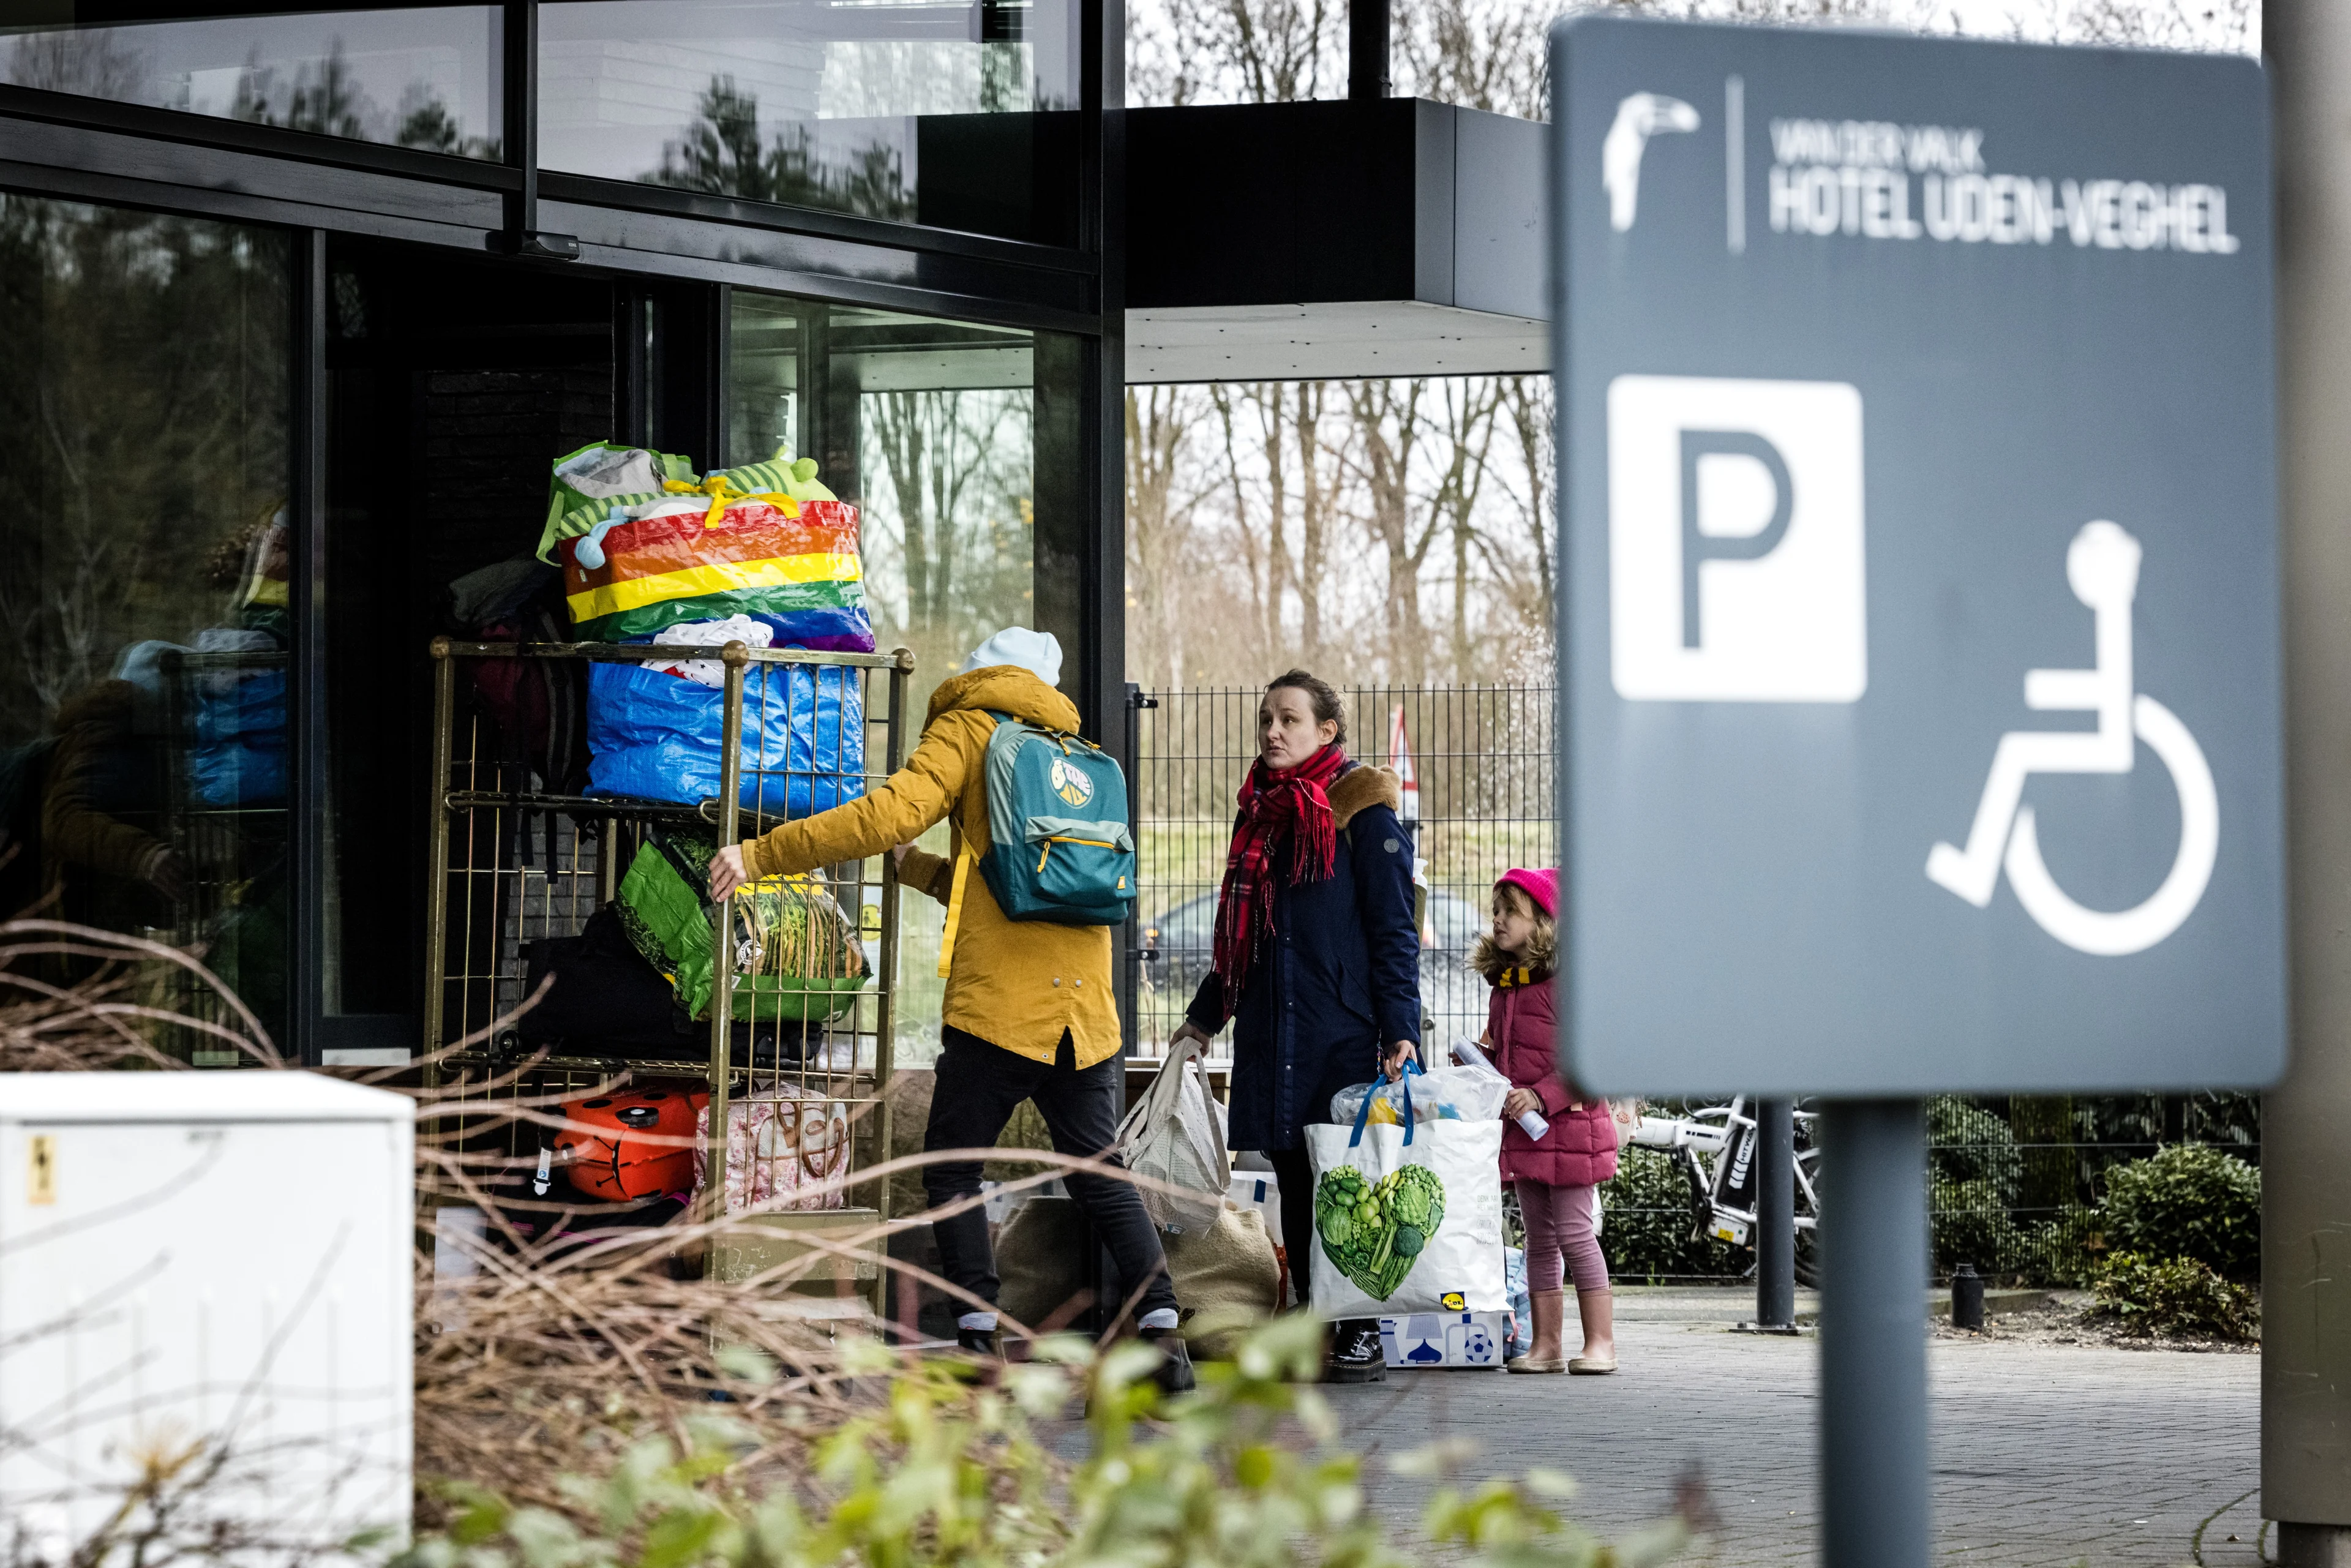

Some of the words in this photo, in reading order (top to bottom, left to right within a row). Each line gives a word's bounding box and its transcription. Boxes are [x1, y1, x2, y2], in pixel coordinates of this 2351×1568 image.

[1769, 167, 1922, 239] HOTEL
[1924, 173, 2240, 253] UDEN-VEGHEL
[1679, 429, 1794, 649] P
